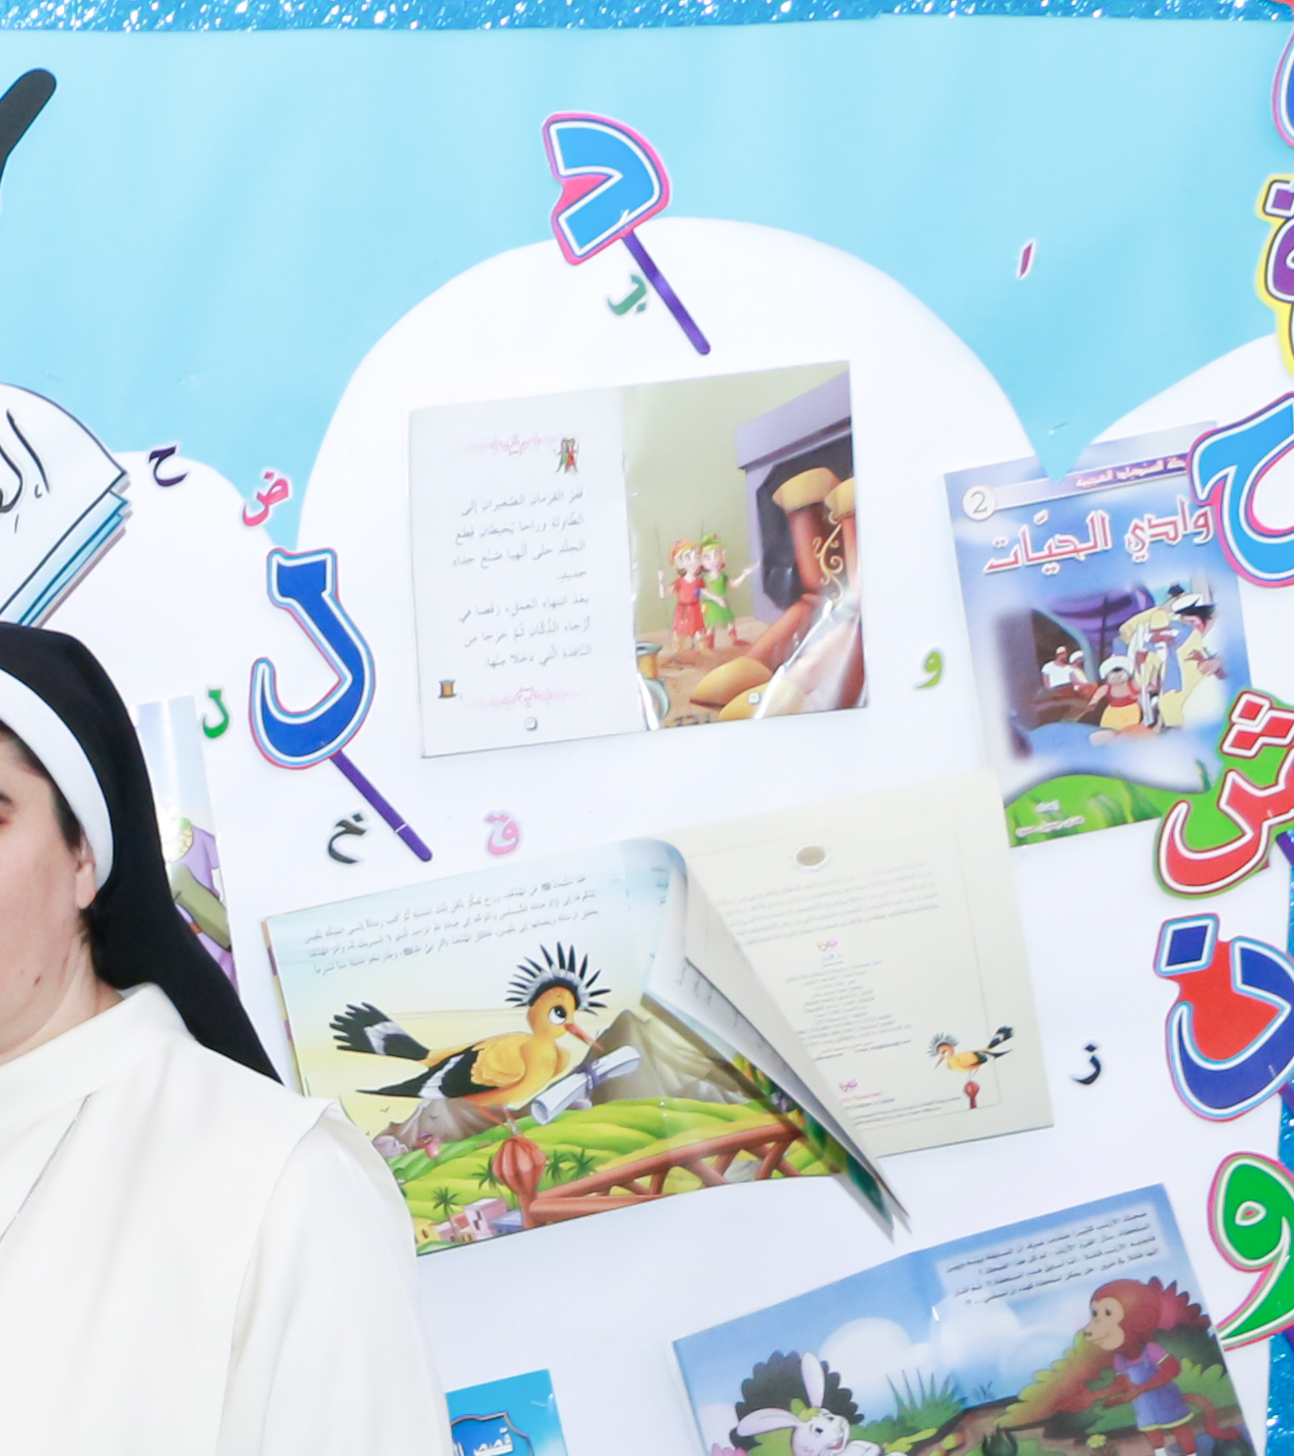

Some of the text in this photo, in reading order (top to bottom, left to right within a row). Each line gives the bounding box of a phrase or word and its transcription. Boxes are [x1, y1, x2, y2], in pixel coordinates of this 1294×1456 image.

[148, 446, 187, 487] ح
[243, 471, 289, 527] ض
[969, 491, 988, 514] 2
[1125, 494, 1214, 563] وادي
[915, 649, 942, 690] و
[1072, 1042, 1102, 1086] ز
